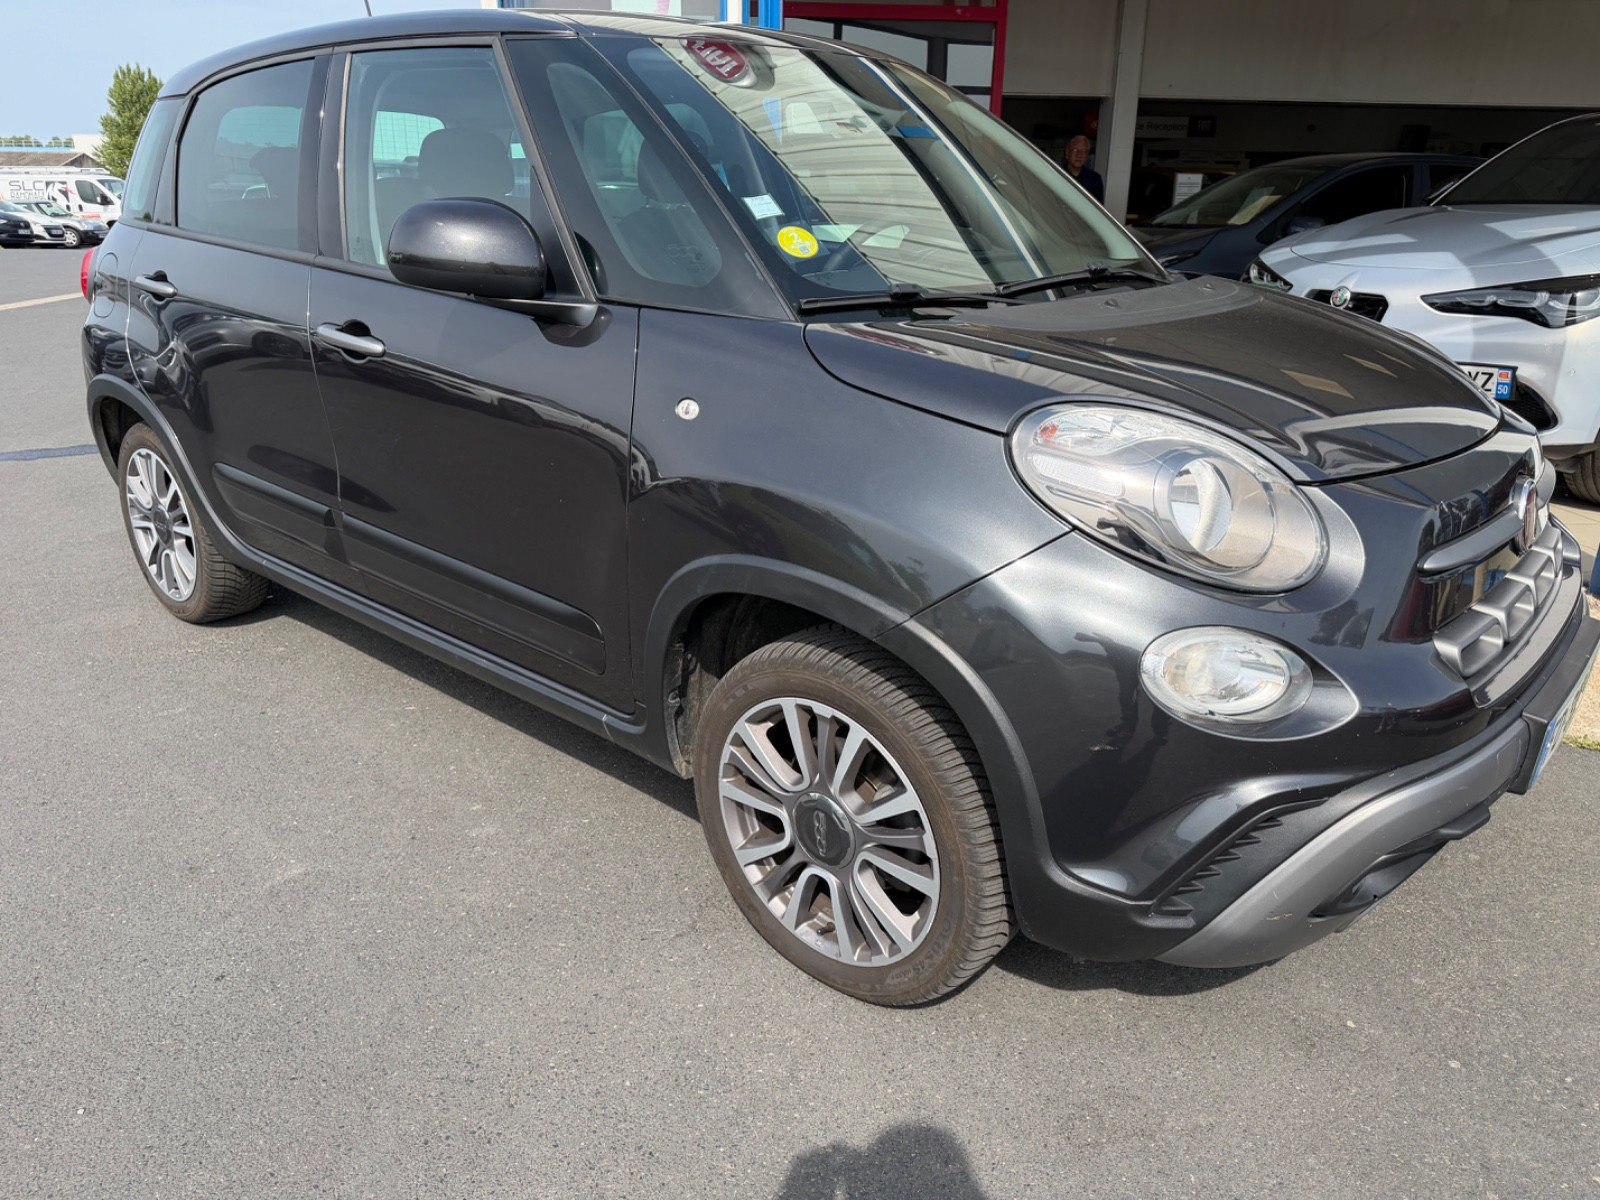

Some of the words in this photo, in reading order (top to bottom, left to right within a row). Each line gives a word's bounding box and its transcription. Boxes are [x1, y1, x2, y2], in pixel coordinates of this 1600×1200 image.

[1146, 121, 1188, 132] Réception
[9, 180, 45, 191] SLC
[1497, 385, 1508, 394] 50
